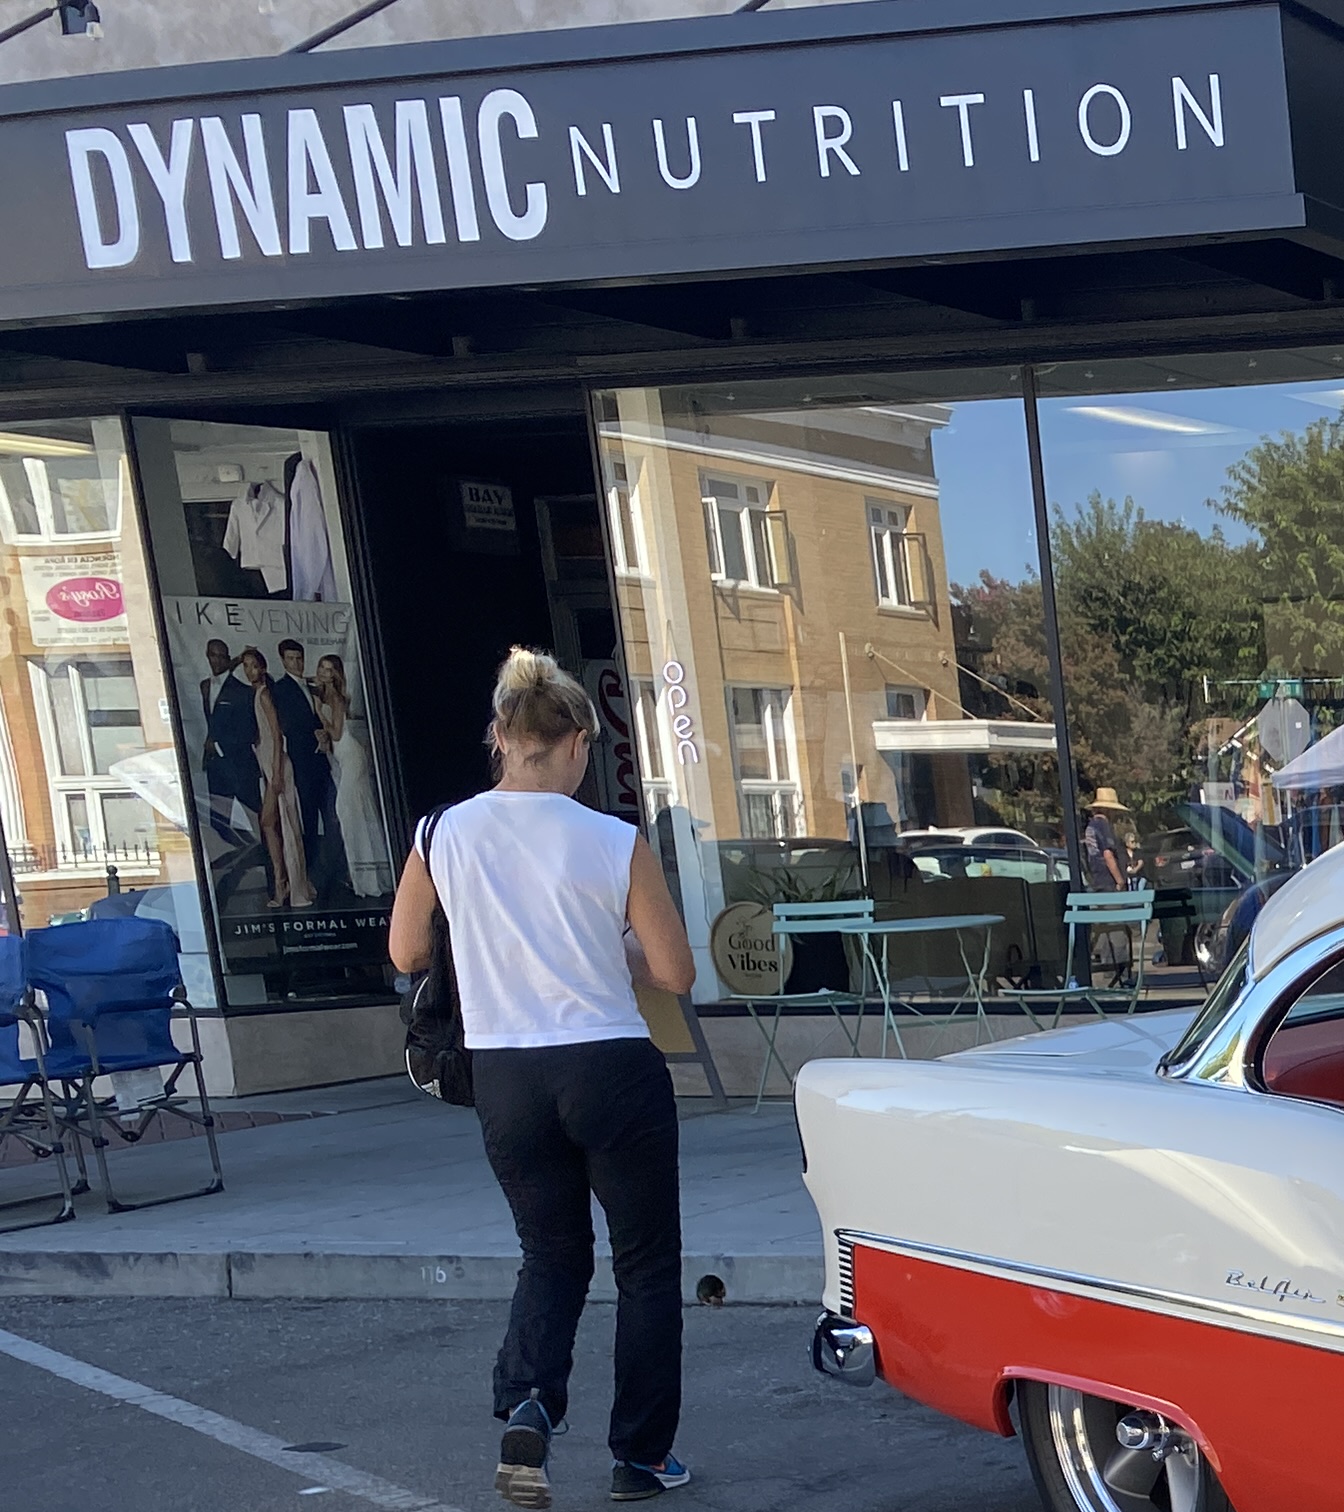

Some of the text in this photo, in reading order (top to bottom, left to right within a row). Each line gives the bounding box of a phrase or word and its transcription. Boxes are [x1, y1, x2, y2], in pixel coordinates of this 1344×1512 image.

[65, 72, 1226, 270] DYNAMIC NUTRITION
[176, 602, 351, 634] IKE EVENING
[662, 660, 699, 766] open
[234, 916, 391, 935] JIM'S FORMAL WEA
[728, 932, 776, 952] Good
[728, 952, 778, 973] Vibes
